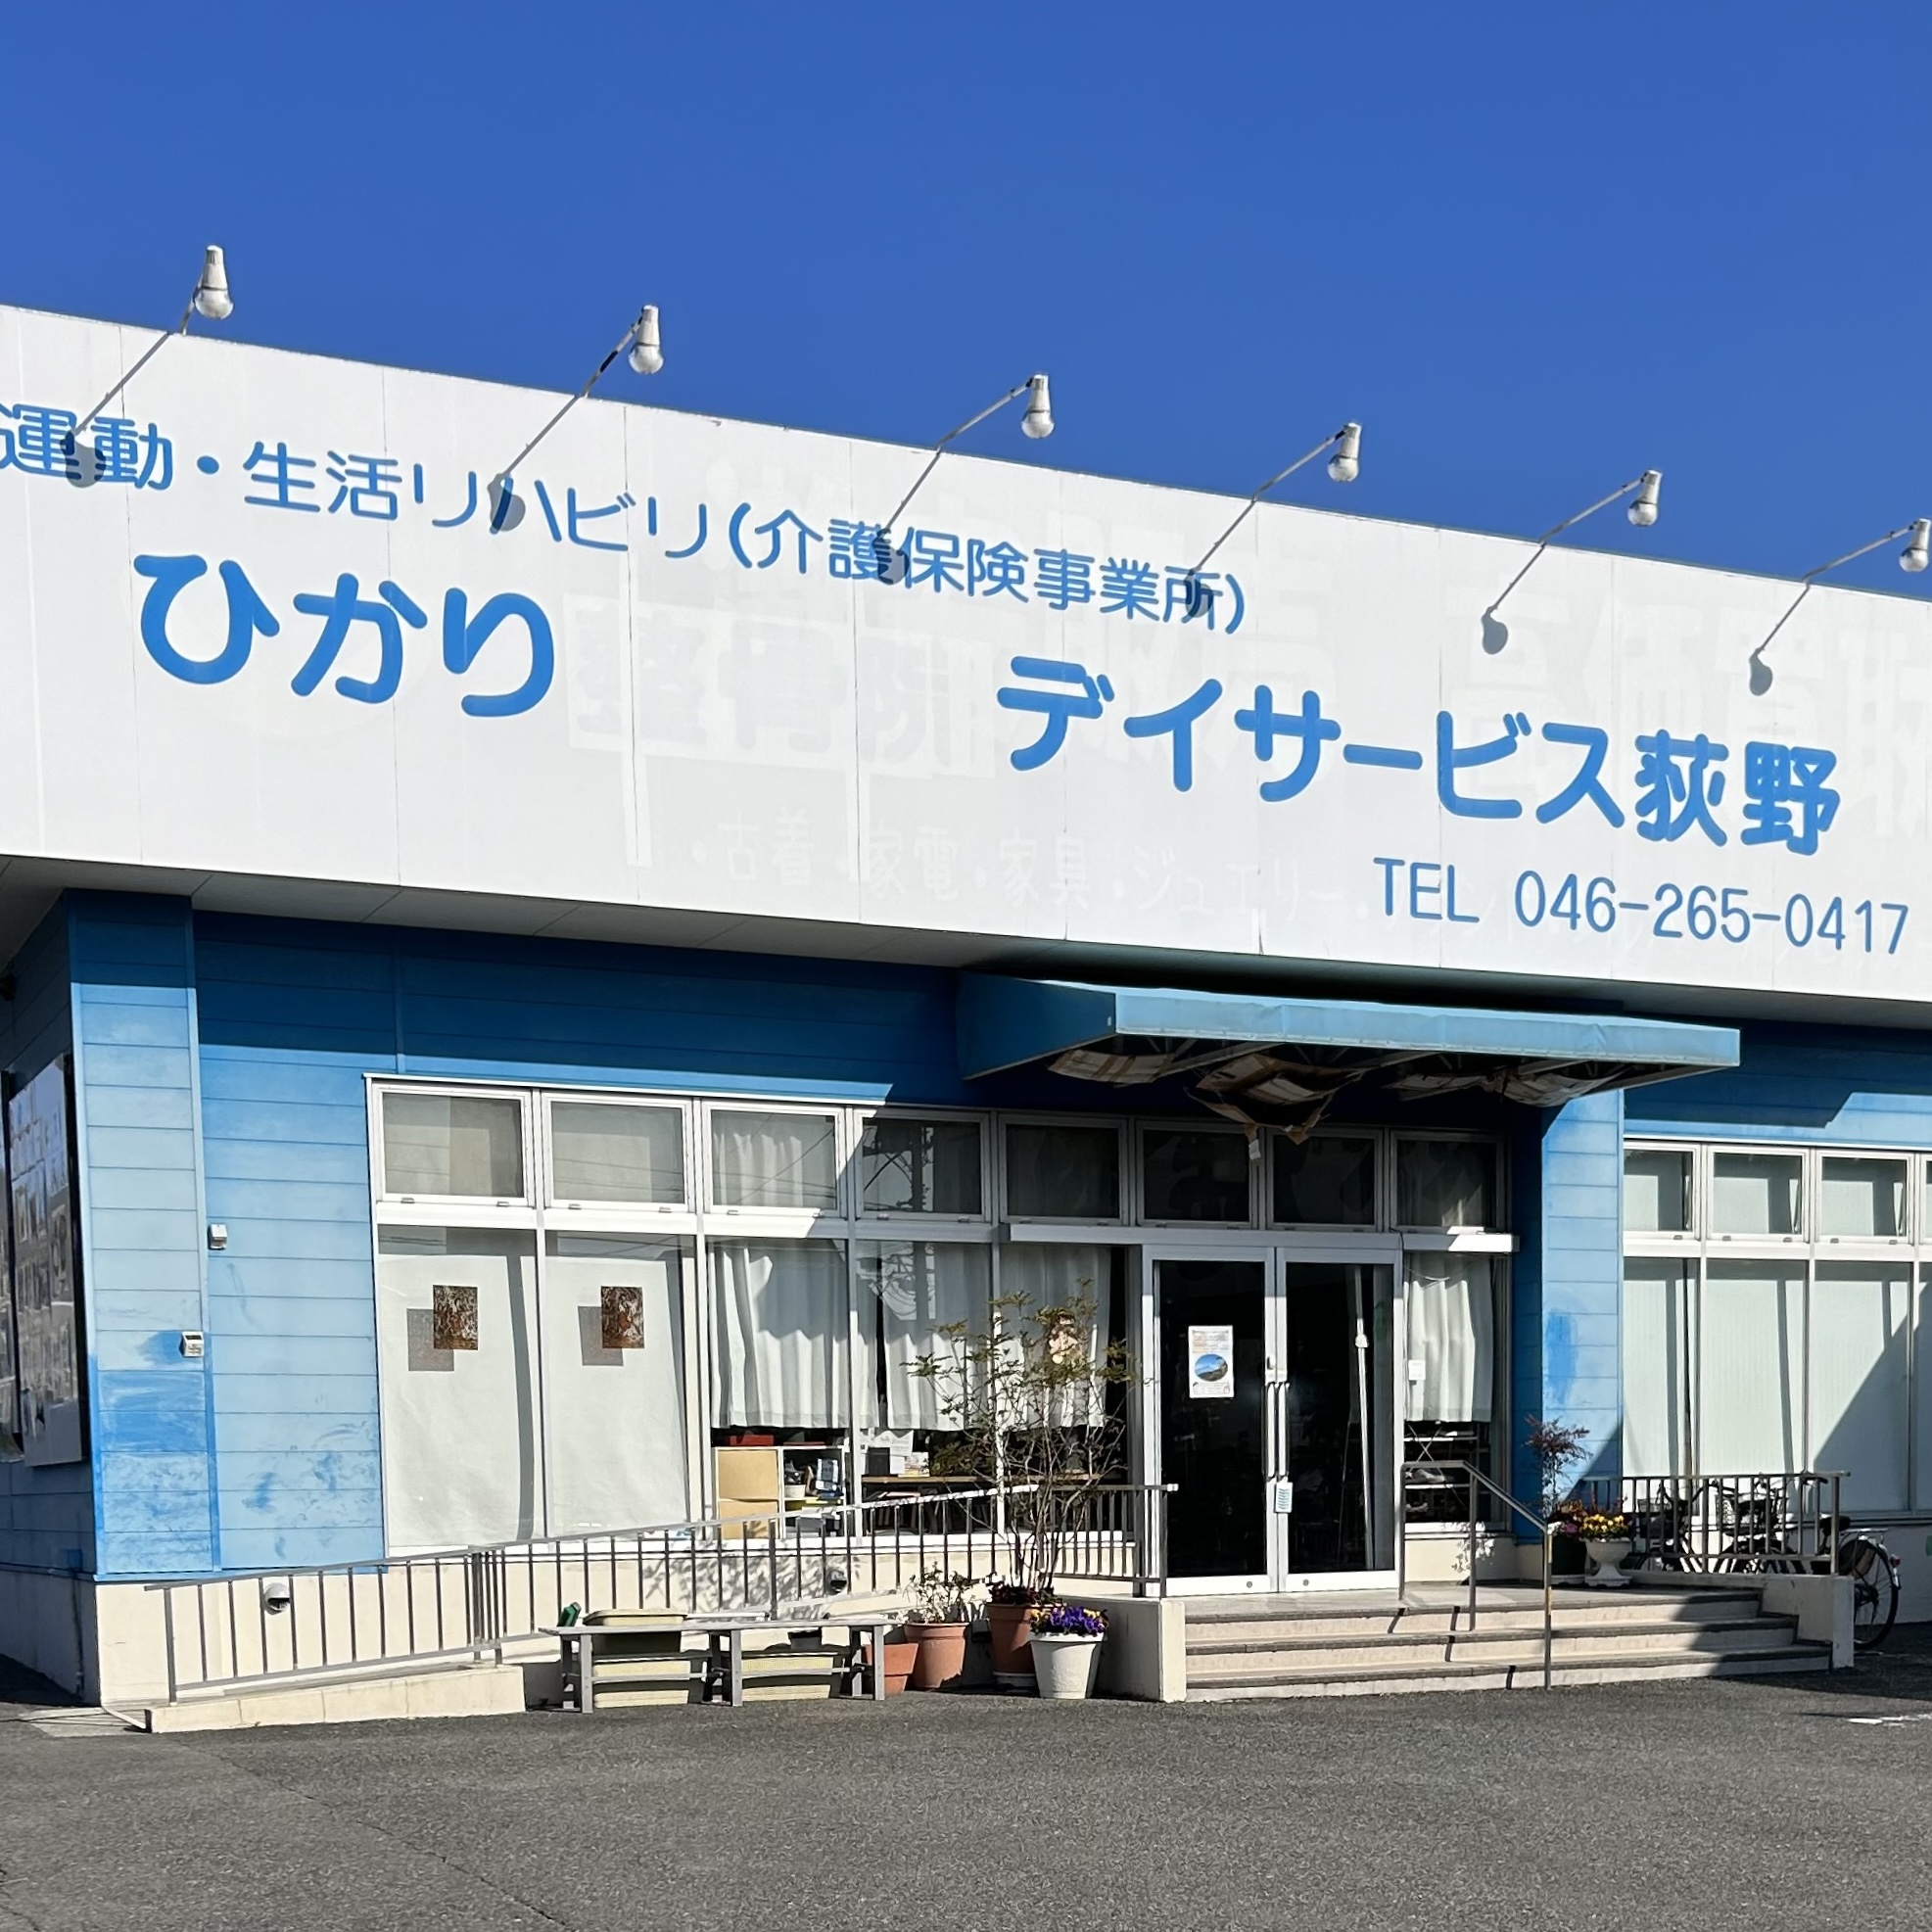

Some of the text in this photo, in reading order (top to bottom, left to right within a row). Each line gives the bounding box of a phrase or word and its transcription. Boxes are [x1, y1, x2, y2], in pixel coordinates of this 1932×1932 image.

[133, 553, 555, 718] ひかり
[997, 655, 1841, 856] デイサービス荻野
[1375, 856, 1909, 955] TEL 046-265-0417
